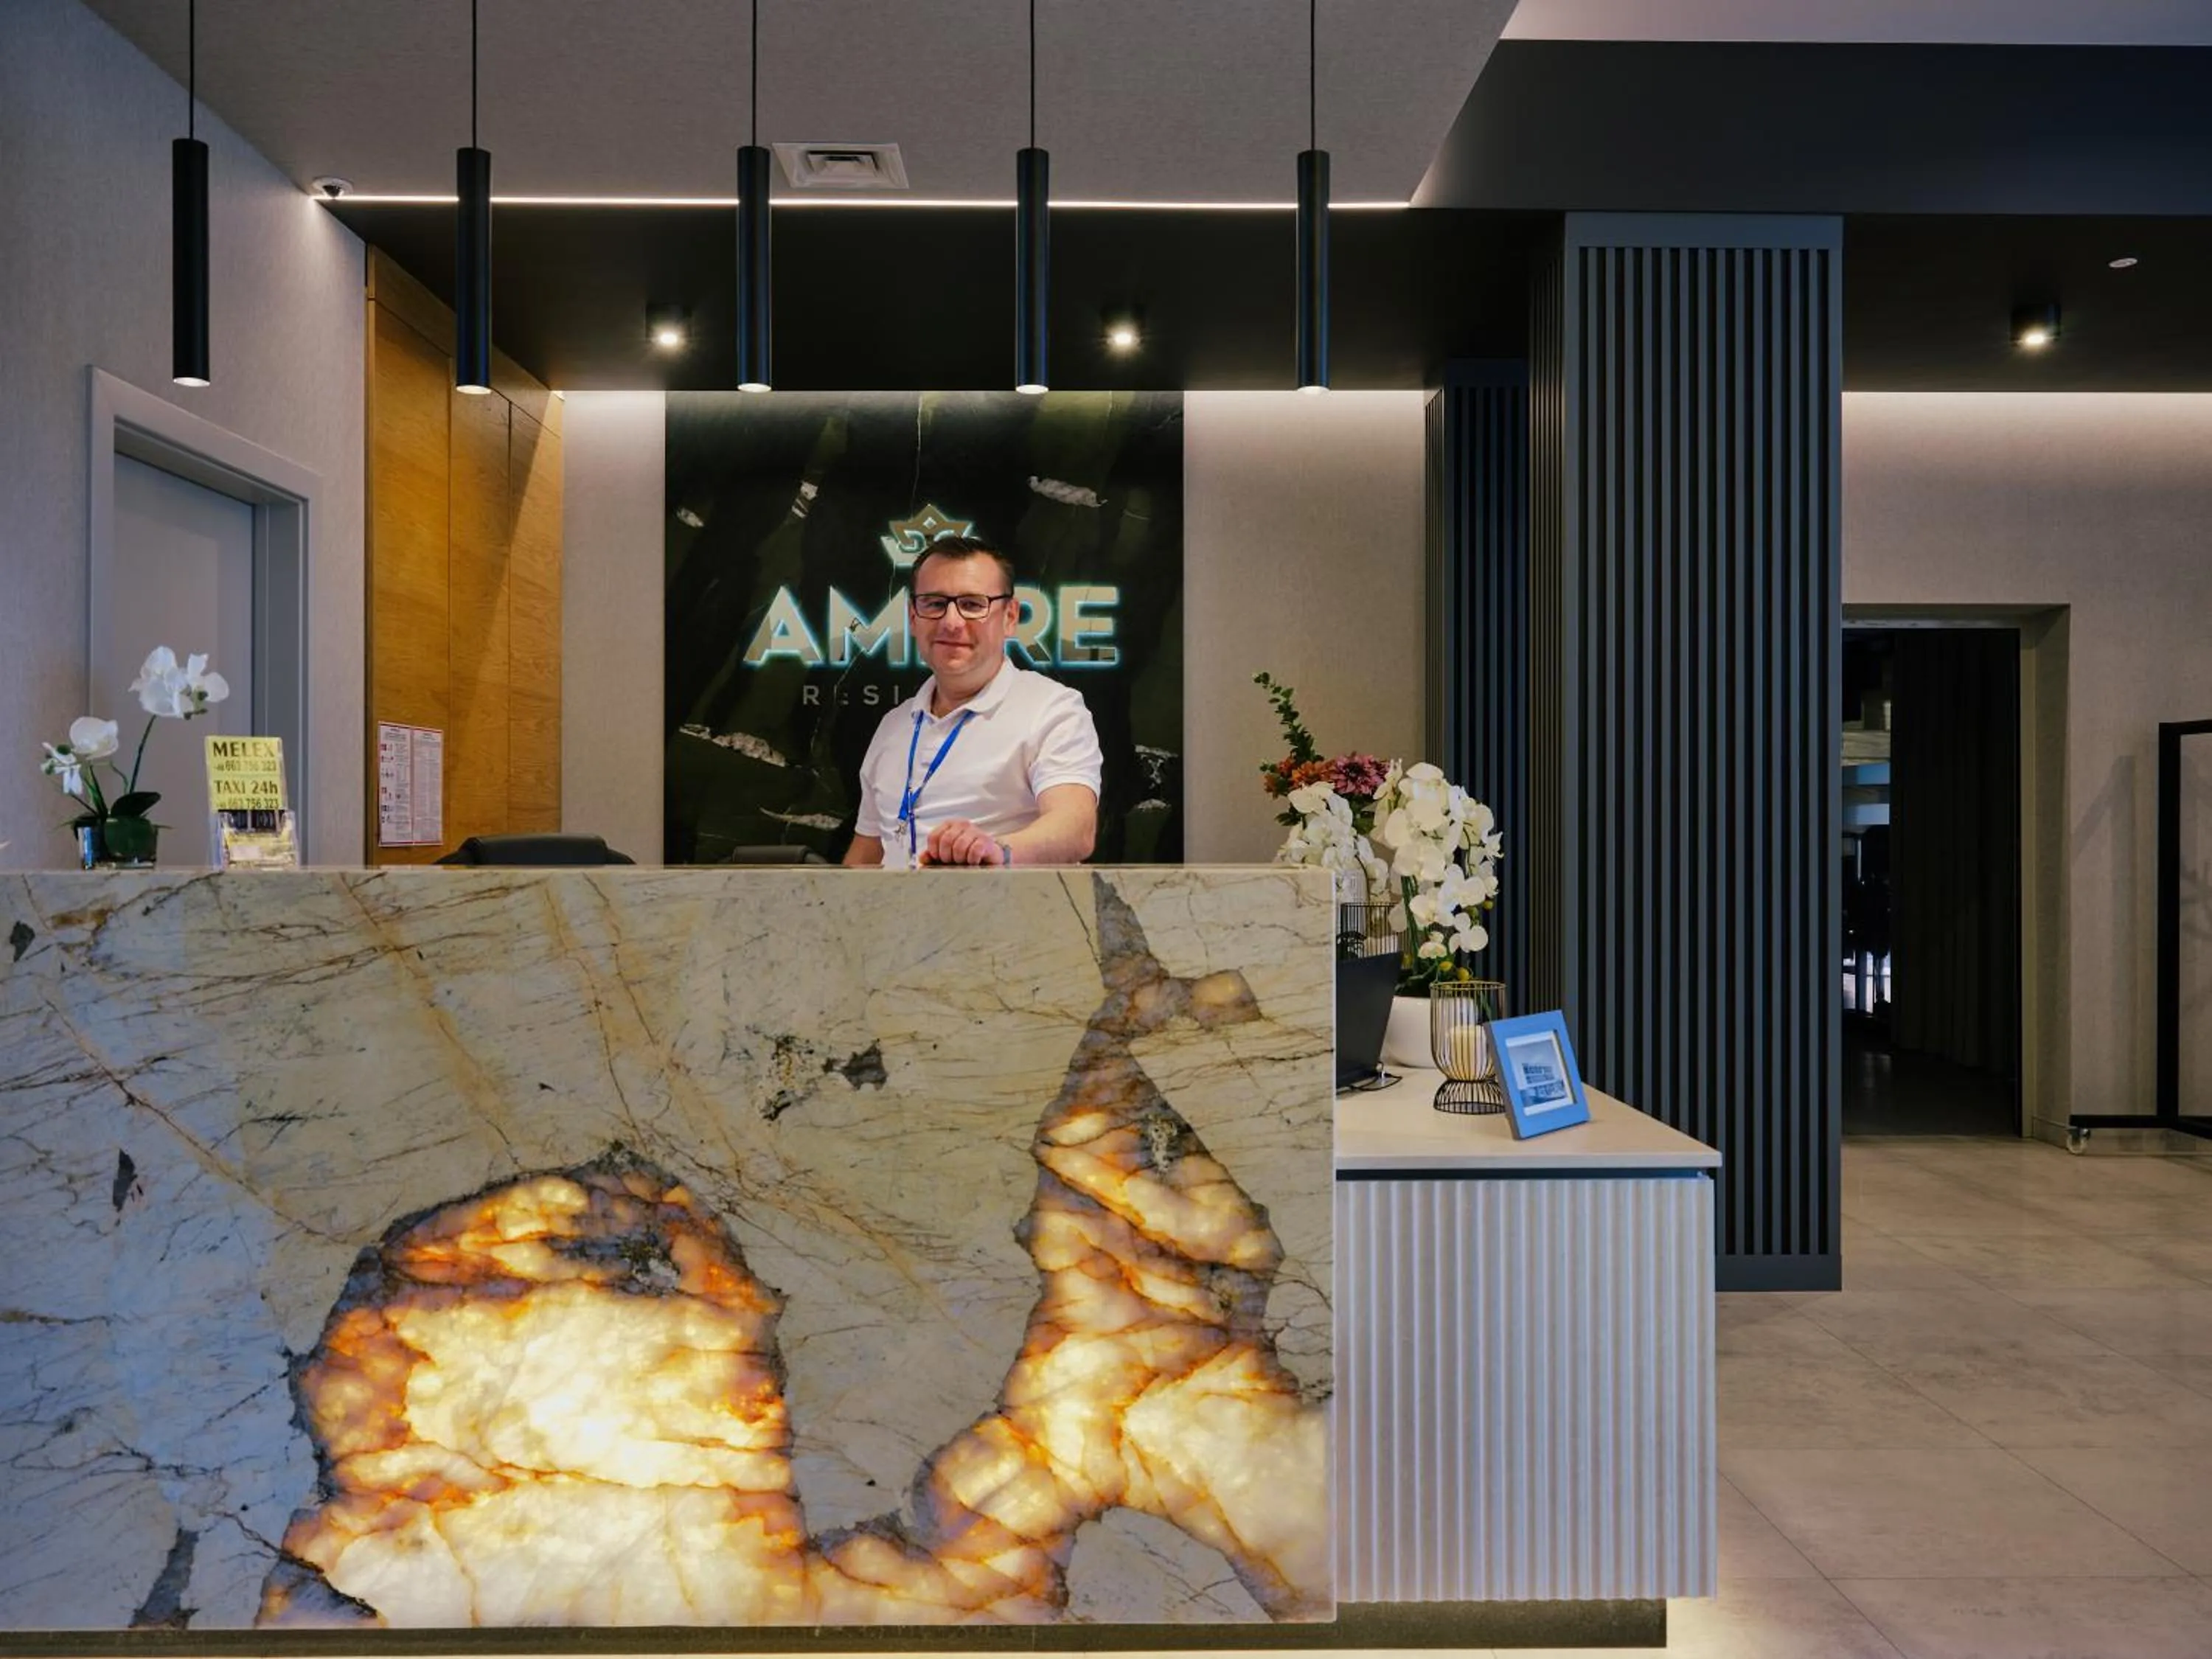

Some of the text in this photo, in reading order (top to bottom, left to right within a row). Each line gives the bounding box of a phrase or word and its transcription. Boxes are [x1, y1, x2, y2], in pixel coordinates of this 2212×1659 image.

[743, 585, 1119, 664] AMRE
[212, 740, 275, 757] MELEX
[213, 779, 278, 794] TAXI 24h
